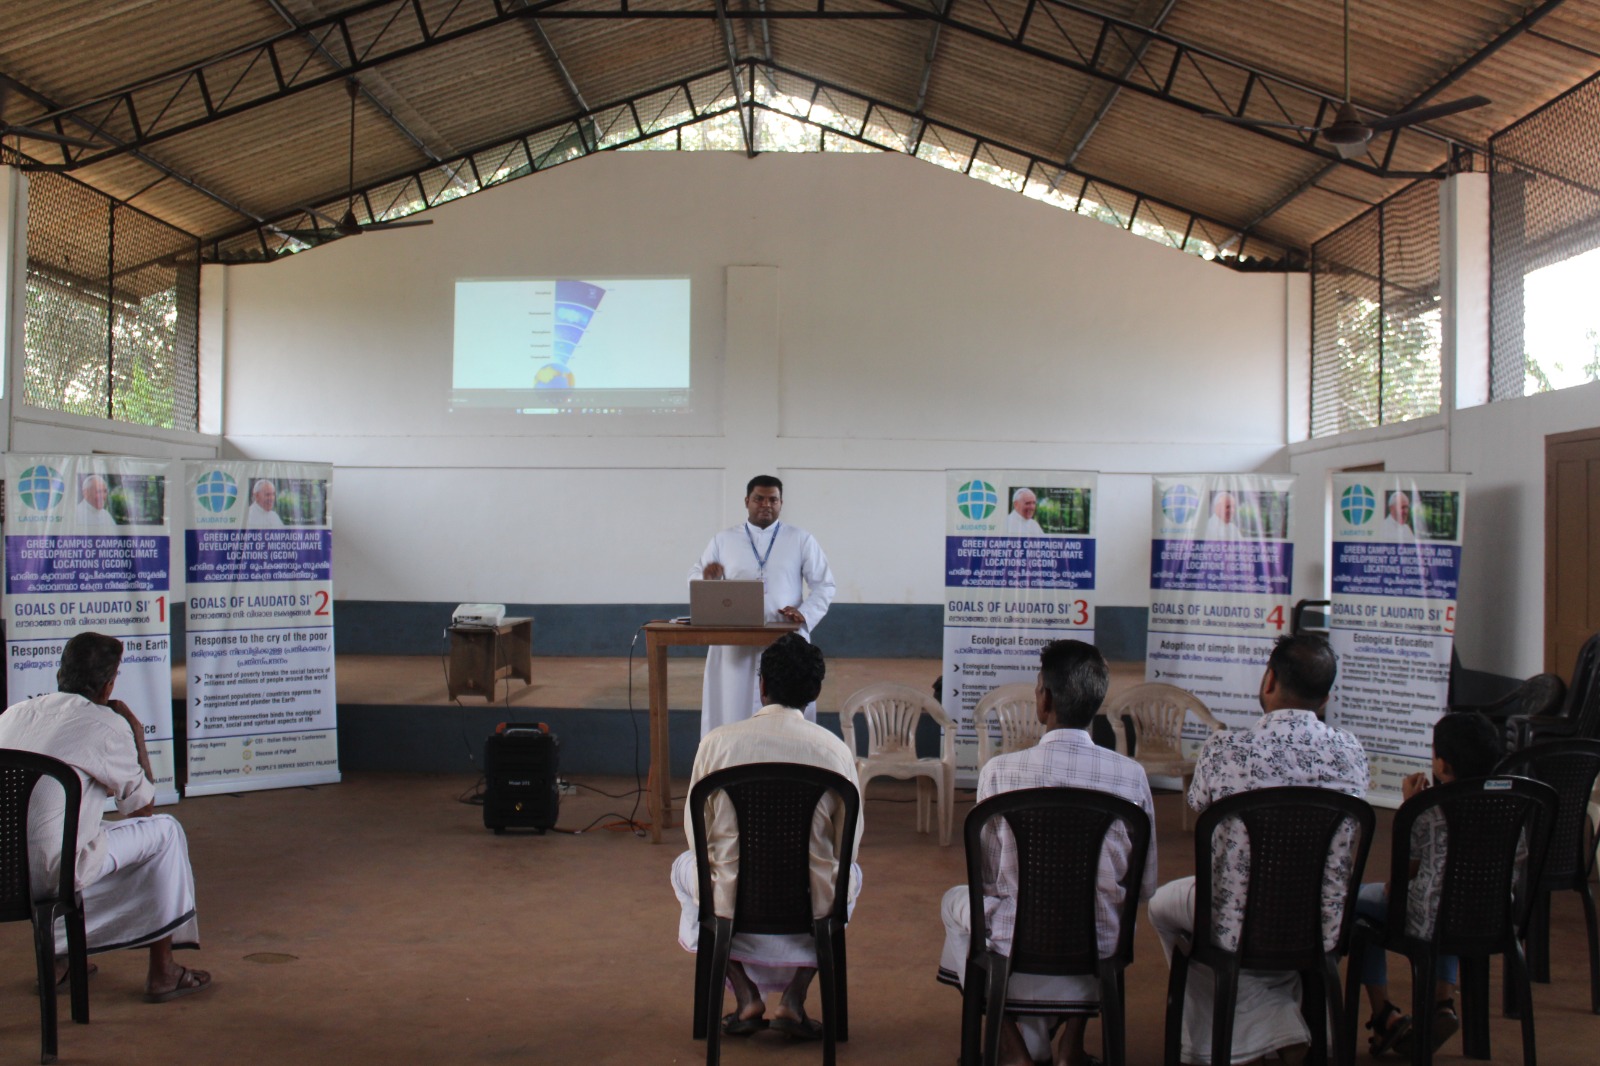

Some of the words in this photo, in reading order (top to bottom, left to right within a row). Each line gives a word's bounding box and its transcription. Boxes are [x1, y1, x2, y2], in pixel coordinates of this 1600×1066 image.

[203, 533, 229, 541] GREEN
[230, 533, 262, 541] CAMPUS
[264, 533, 303, 541] CAMPAIGN
[304, 533, 320, 541] AND
[26, 540, 54, 548] GREEN
[56, 539, 93, 548] CAMPUS
[95, 539, 138, 548] CAMPAIGN
[139, 539, 156, 548] AND
[199, 542, 253, 551] DEVELOPMENT
[254, 542, 265, 550] OF
[267, 542, 322, 550] MICROCLIMATE
[962, 540, 987, 548] GREEN
[988, 540, 1021, 549] CAMPUS
[1022, 540, 1063, 550] CAMPAIGN
[1064, 541, 1081, 550] AND
[21, 550, 82, 559] DEVELOPMENT
[84, 550, 96, 558] OF
[98, 549, 158, 558] MICROCLIMATE
[226, 552, 268, 560] LOCATIONS
[270, 552, 298, 560] (GCDM)
[958, 549, 1012, 558] DEVELOPMENT
[1013, 550, 1024, 558] OF
[1025, 550, 1083, 559] MICROCLIMATE
[1343, 545, 1366, 554] GREEN
[1367, 546, 1395, 555] CAMPUS
[1397, 547, 1435, 557] CAMPAIGN
[1436, 549, 1452, 557] AND
[53, 559, 99, 569] LOCATIONS
[101, 559, 132, 569] (GCDM)
[985, 558, 1026, 567] LOCATIONS
[1026, 559, 1057, 568] (GCDM)
[15, 603, 55, 616] GOALS
[59, 603, 75, 615] OF
[79, 602, 132, 614] LAUDATO
[155, 596, 164, 622] 1
[190, 597, 226, 609] GOALS
[229, 596, 244, 608] OF
[247, 595, 296, 607] LAUDATO
[314, 590, 329, 616] 2
[948, 601, 984, 612] GOALS
[987, 602, 1000, 613] OF
[1004, 602, 1054, 614] LAUDATO
[1073, 600, 1088, 625] 3
[1152, 603, 1184, 615] GOALS
[1186, 604, 1200, 616] OF
[1203, 605, 1250, 618] LAUDATO
[1266, 605, 1285, 630] 4
[1333, 604, 1362, 616] GOALS
[1364, 605, 1377, 617] OF
[1380, 606, 1424, 620] LAUDATO
[127, 640, 142, 650] the
[144, 639, 168, 650] Earth
[194, 635, 237, 647] Response
[239, 634, 248, 644] to
[250, 634, 264, 643] the
[266, 635, 280, 644] cry
[282, 633, 290, 642] of
[292, 633, 306, 642] the
[308, 634, 327, 643] poor
[971, 635, 1016, 648] Ecological
[1354, 633, 1392, 647] Ecological
[1394, 636, 1434, 648] Education
[11, 645, 62, 658] Response
[1160, 641, 1195, 653] Adoption
[1197, 643, 1205, 652] of
[1207, 643, 1235, 655] simple
[1237, 645, 1251, 654] life
[1253, 646, 1273, 657] style
